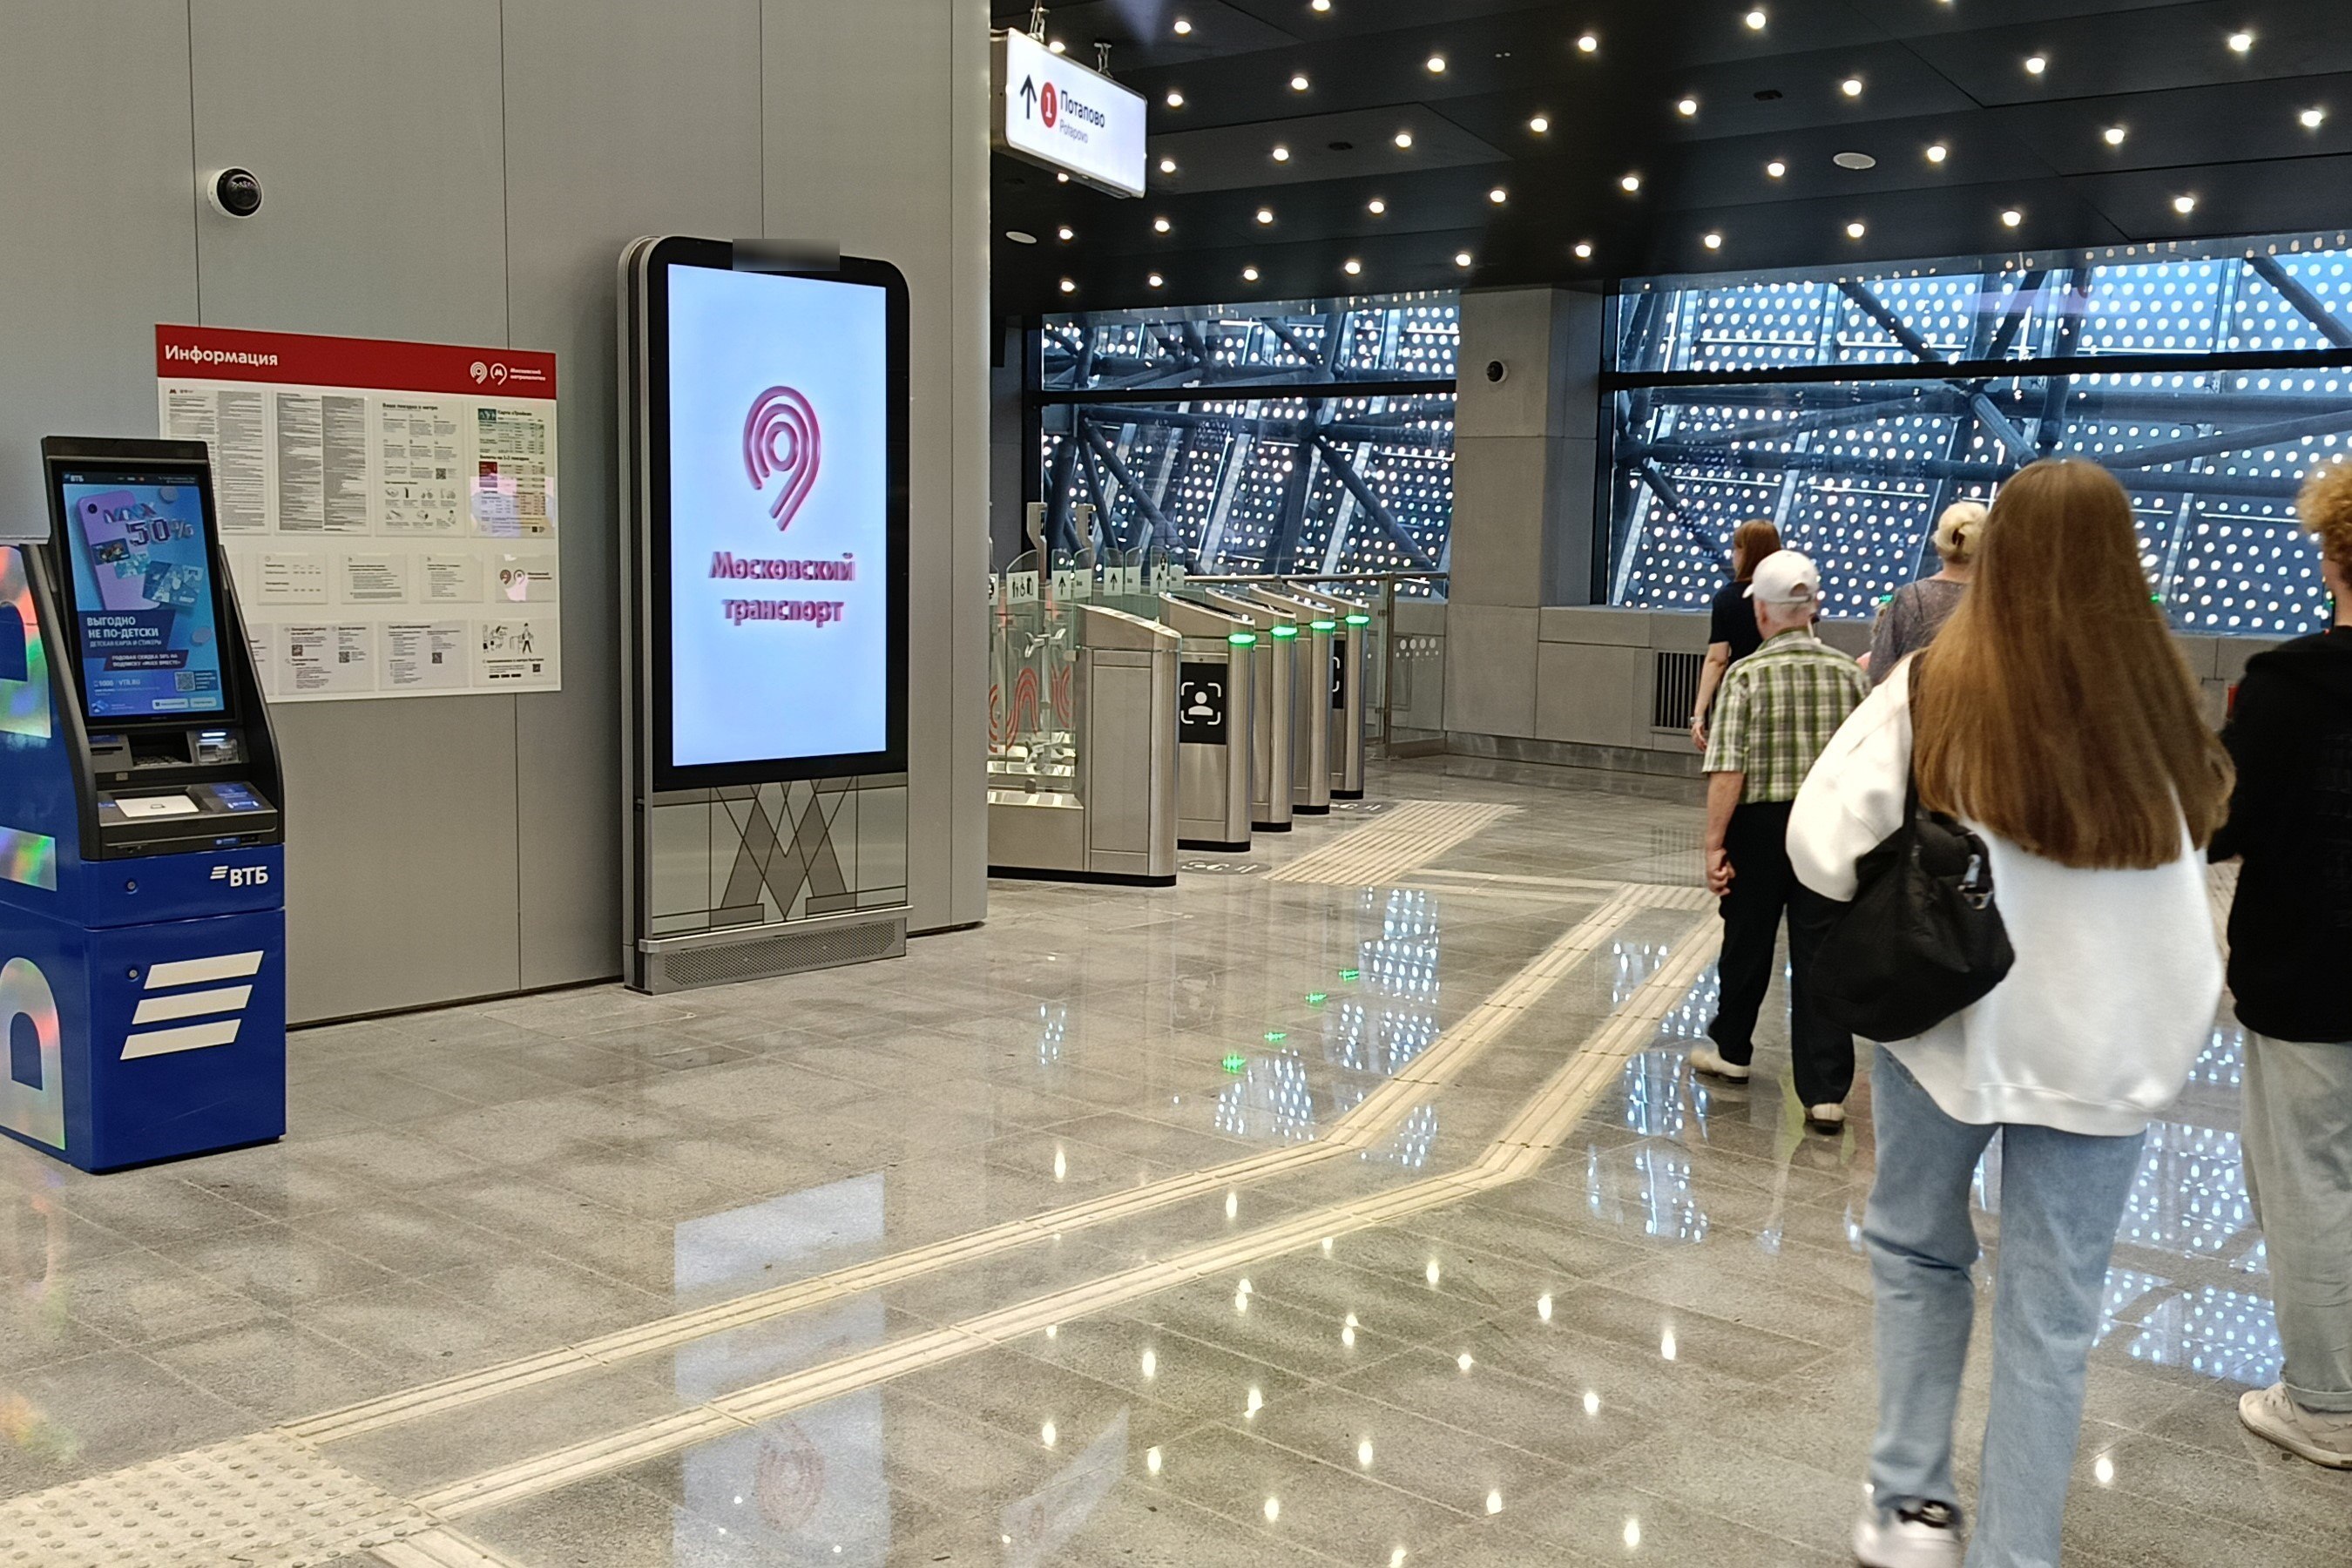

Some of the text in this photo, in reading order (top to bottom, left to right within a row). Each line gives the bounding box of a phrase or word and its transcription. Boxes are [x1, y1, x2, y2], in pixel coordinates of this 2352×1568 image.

[1045, 90, 1105, 128] 1 Потапово
[1060, 118, 1088, 144] Potapovo
[165, 345, 278, 367] Информация
[125, 517, 195, 547] 50%
[708, 551, 855, 581] Московский
[87, 616, 136, 628] ВЫГОДНО
[722, 599, 844, 628] транспорт
[88, 627, 159, 639] НЕ ПО-ДЕТСКИ
[230, 866, 268, 887] ВТБ
